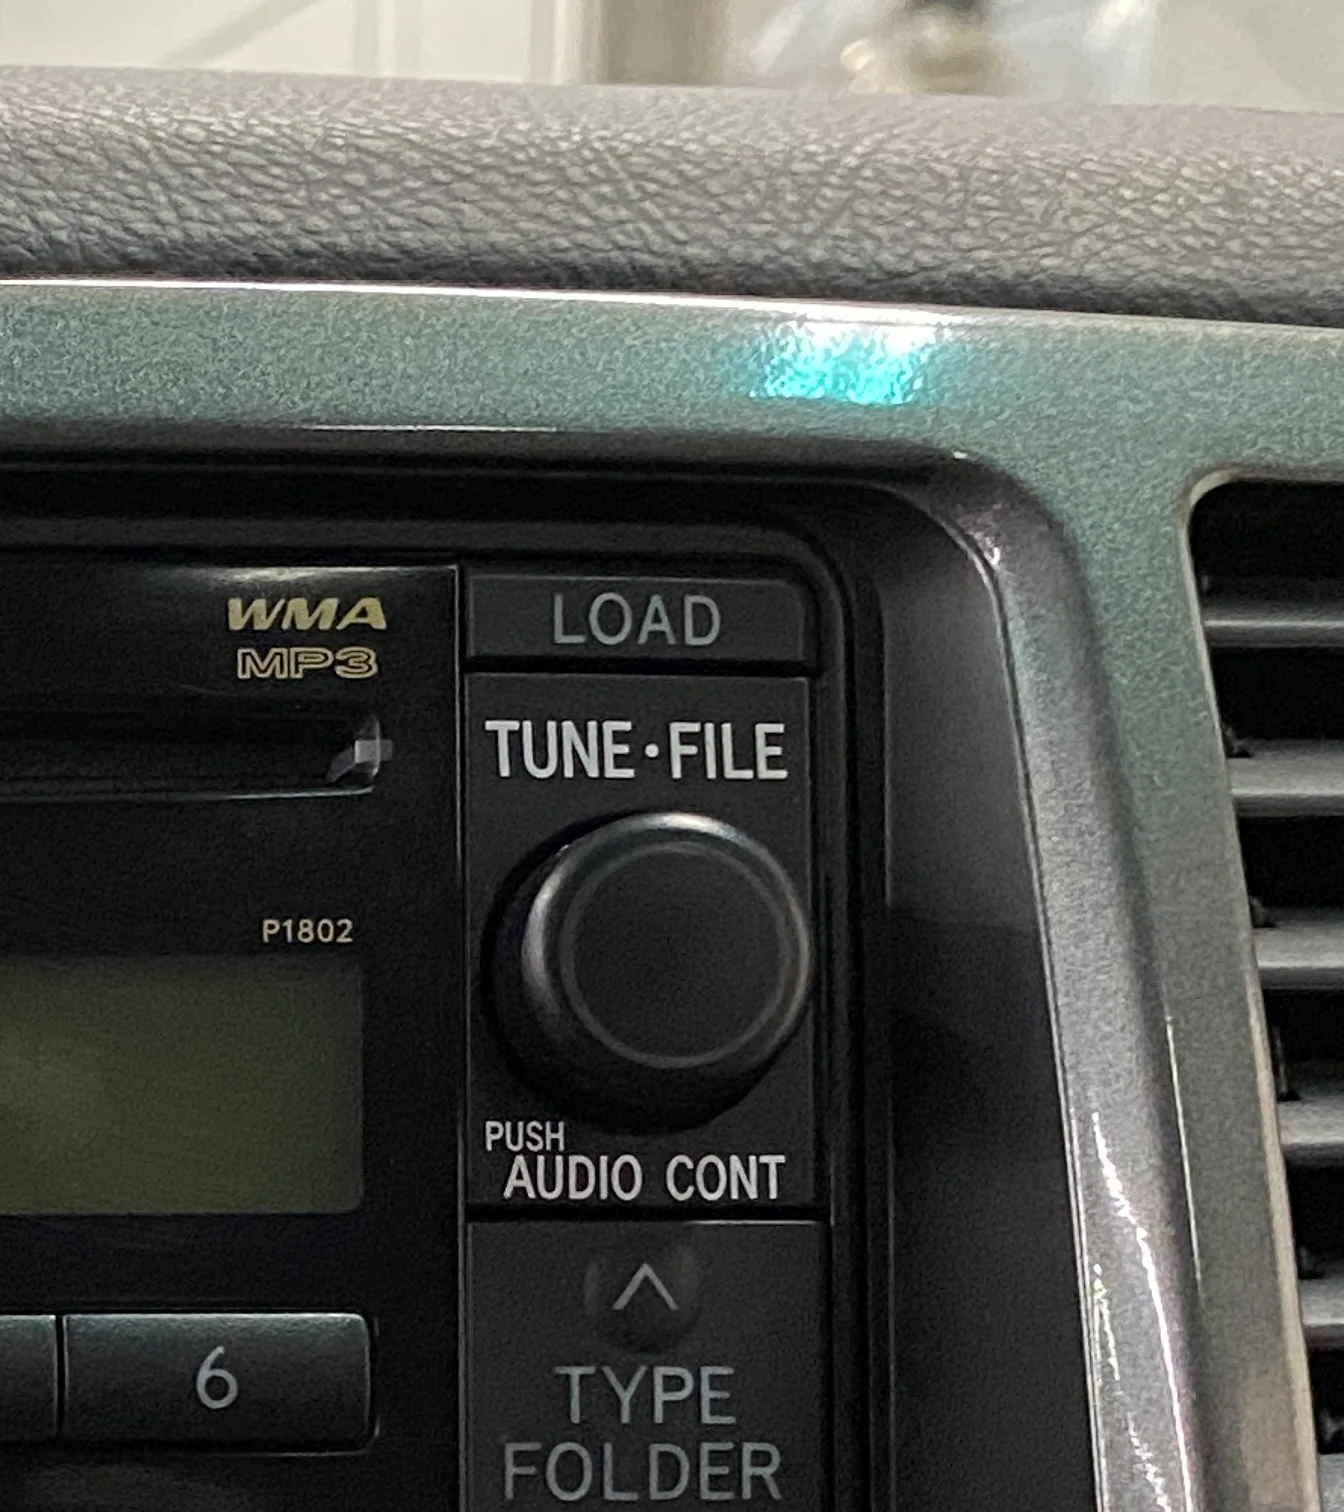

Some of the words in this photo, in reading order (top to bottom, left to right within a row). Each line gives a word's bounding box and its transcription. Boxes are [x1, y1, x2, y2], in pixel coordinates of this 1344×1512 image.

[226, 597, 387, 631] WMA
[553, 592, 721, 645] LOAD
[236, 647, 379, 680] MP3
[262, 918, 354, 944] P1802
[485, 1121, 565, 1152] PUSH
[502, 1155, 643, 1201] AUDIO
[666, 1154, 787, 1201] CONT
[196, 1346, 239, 1409] 6
[554, 1365, 737, 1425] TYPE
[503, 1441, 783, 1501] FOLDER
